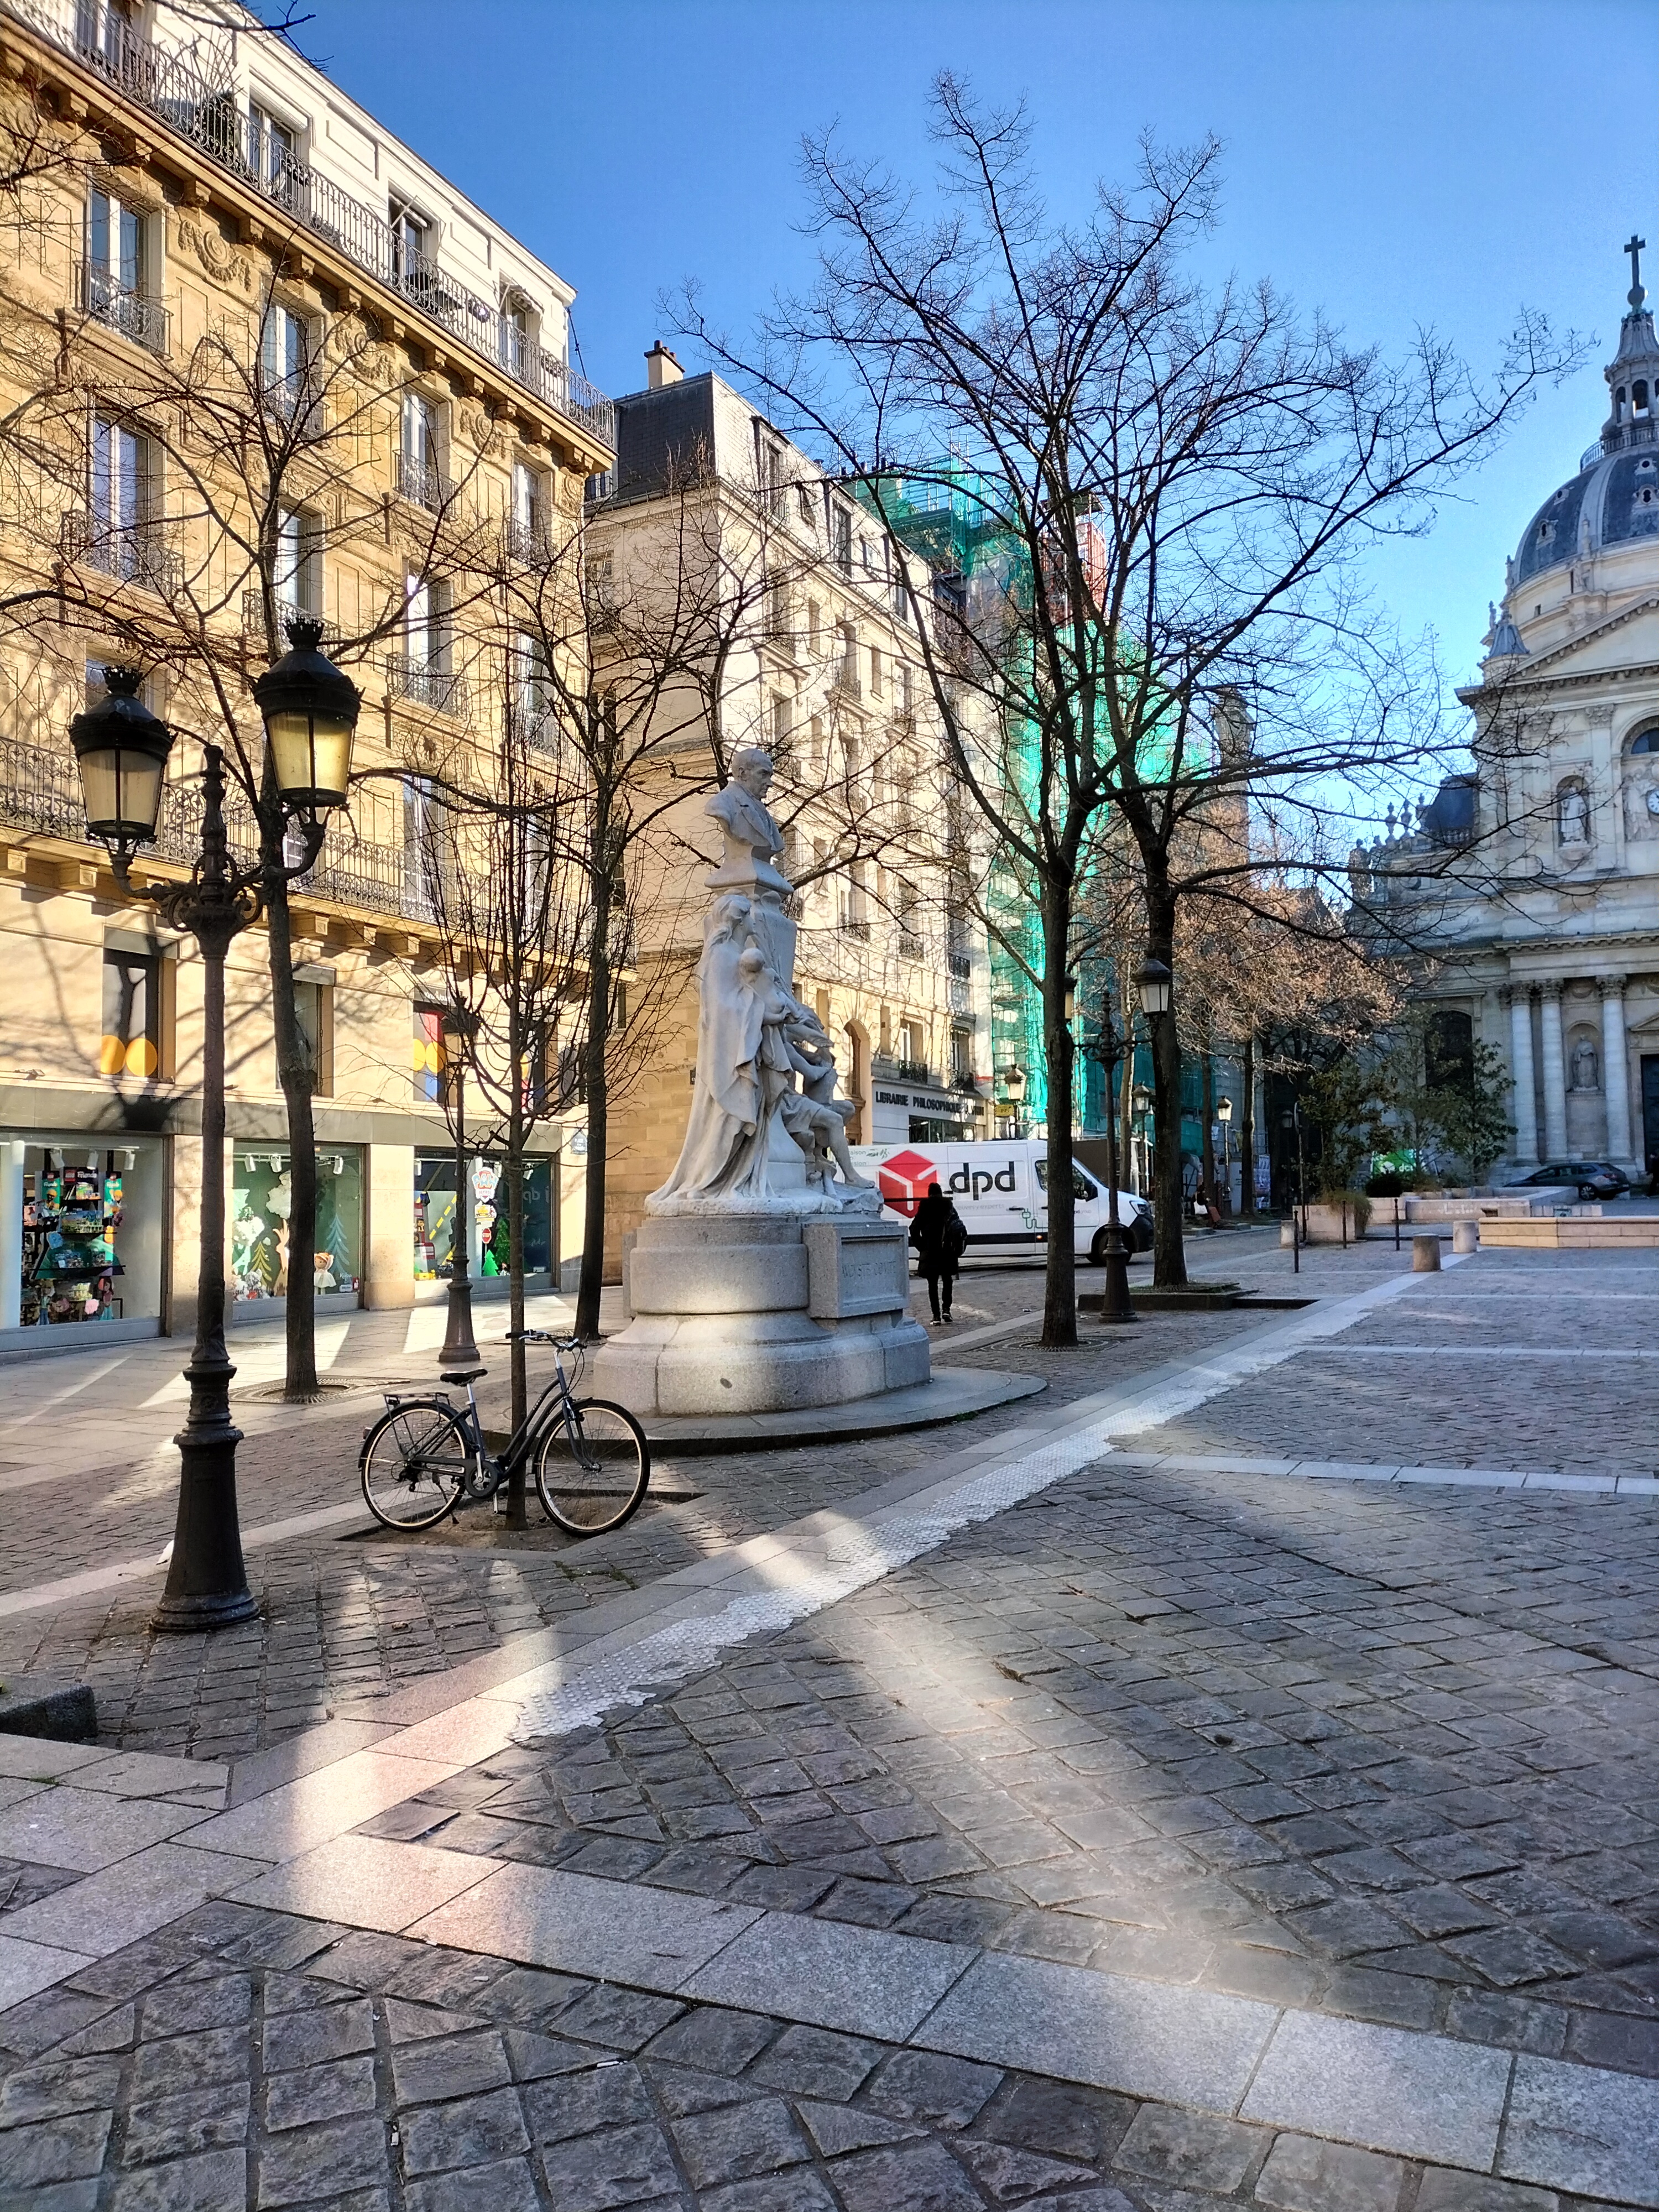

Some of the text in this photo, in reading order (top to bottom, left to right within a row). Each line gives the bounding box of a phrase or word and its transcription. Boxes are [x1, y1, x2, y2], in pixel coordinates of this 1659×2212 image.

[875, 1091, 909, 1106] LIBRAIRIE
[912, 1096, 962, 1113] PHILOSOPHIQUE
[950, 1162, 1016, 1200] dpd
